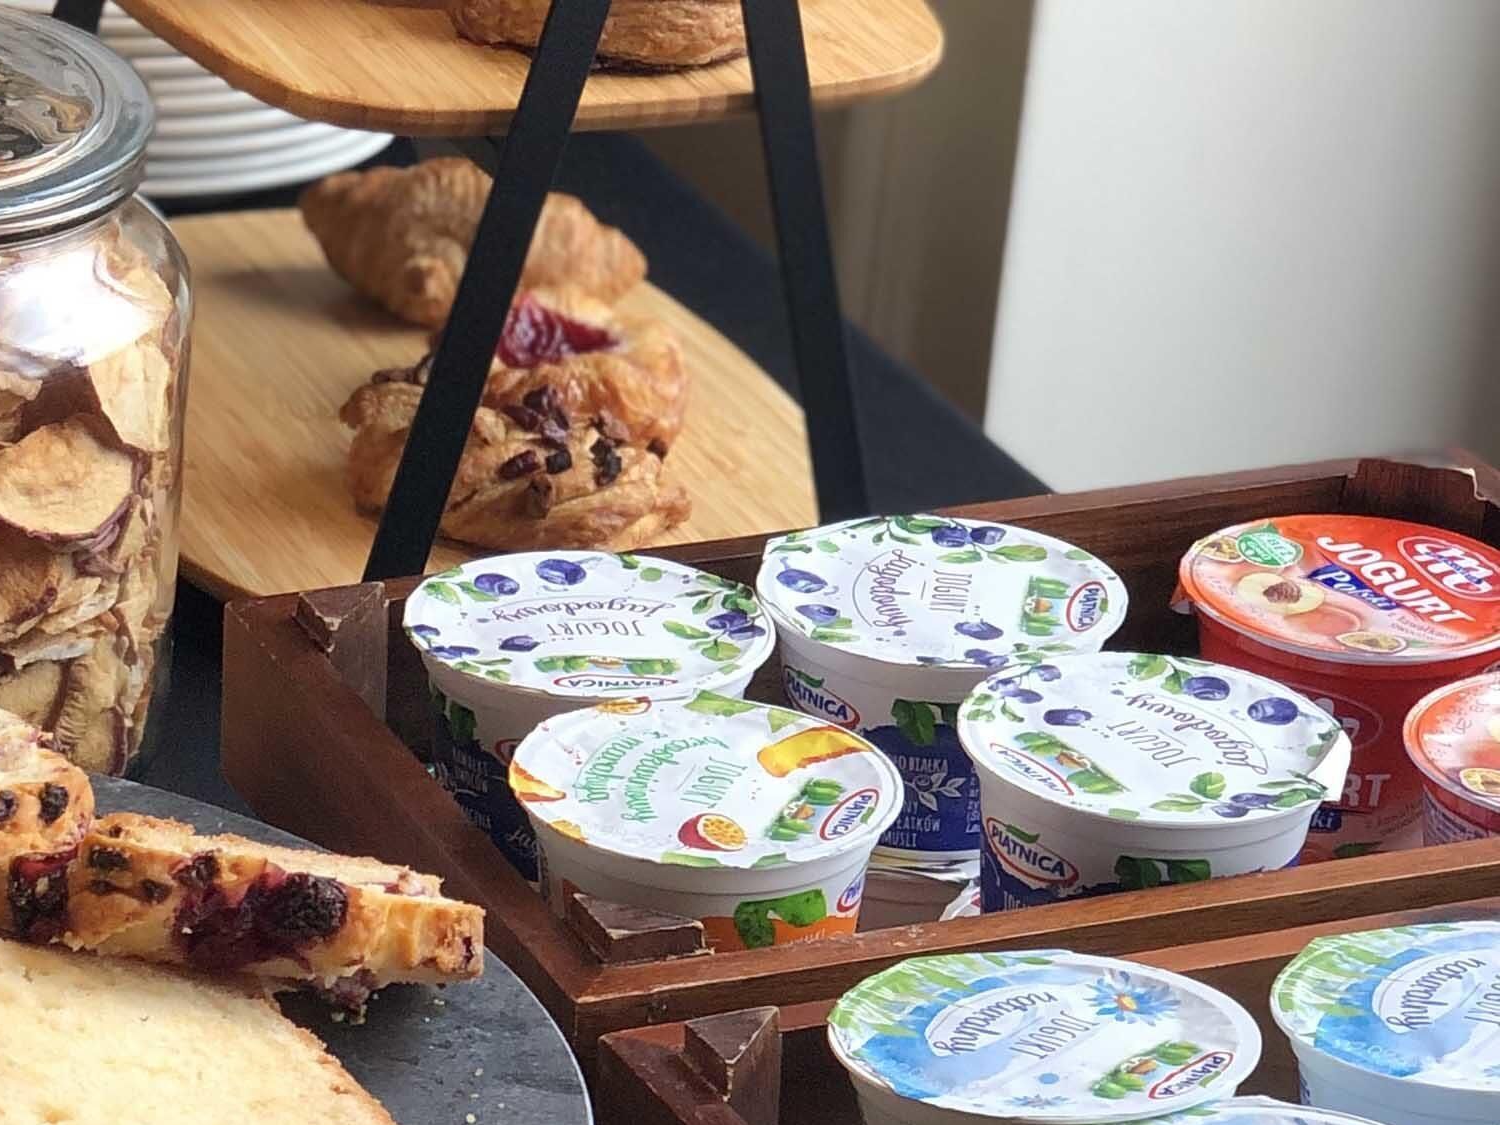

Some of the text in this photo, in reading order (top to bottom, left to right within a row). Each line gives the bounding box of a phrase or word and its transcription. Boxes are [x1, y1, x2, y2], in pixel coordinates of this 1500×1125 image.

[929, 569, 973, 614] JOGURT
[1315, 569, 1390, 610] Polski
[1316, 536, 1476, 623] JOGURT
[546, 618, 645, 637] JOGURT
[1106, 719, 1202, 769] JOGURT
[680, 756, 748, 809] JOGURT
[897, 811, 941, 832] ŁATKÓW
[1386, 958, 1487, 1030] naturalny
[934, 990, 1058, 1056] naturalny
[1009, 1010, 1101, 1060] JOGURT
